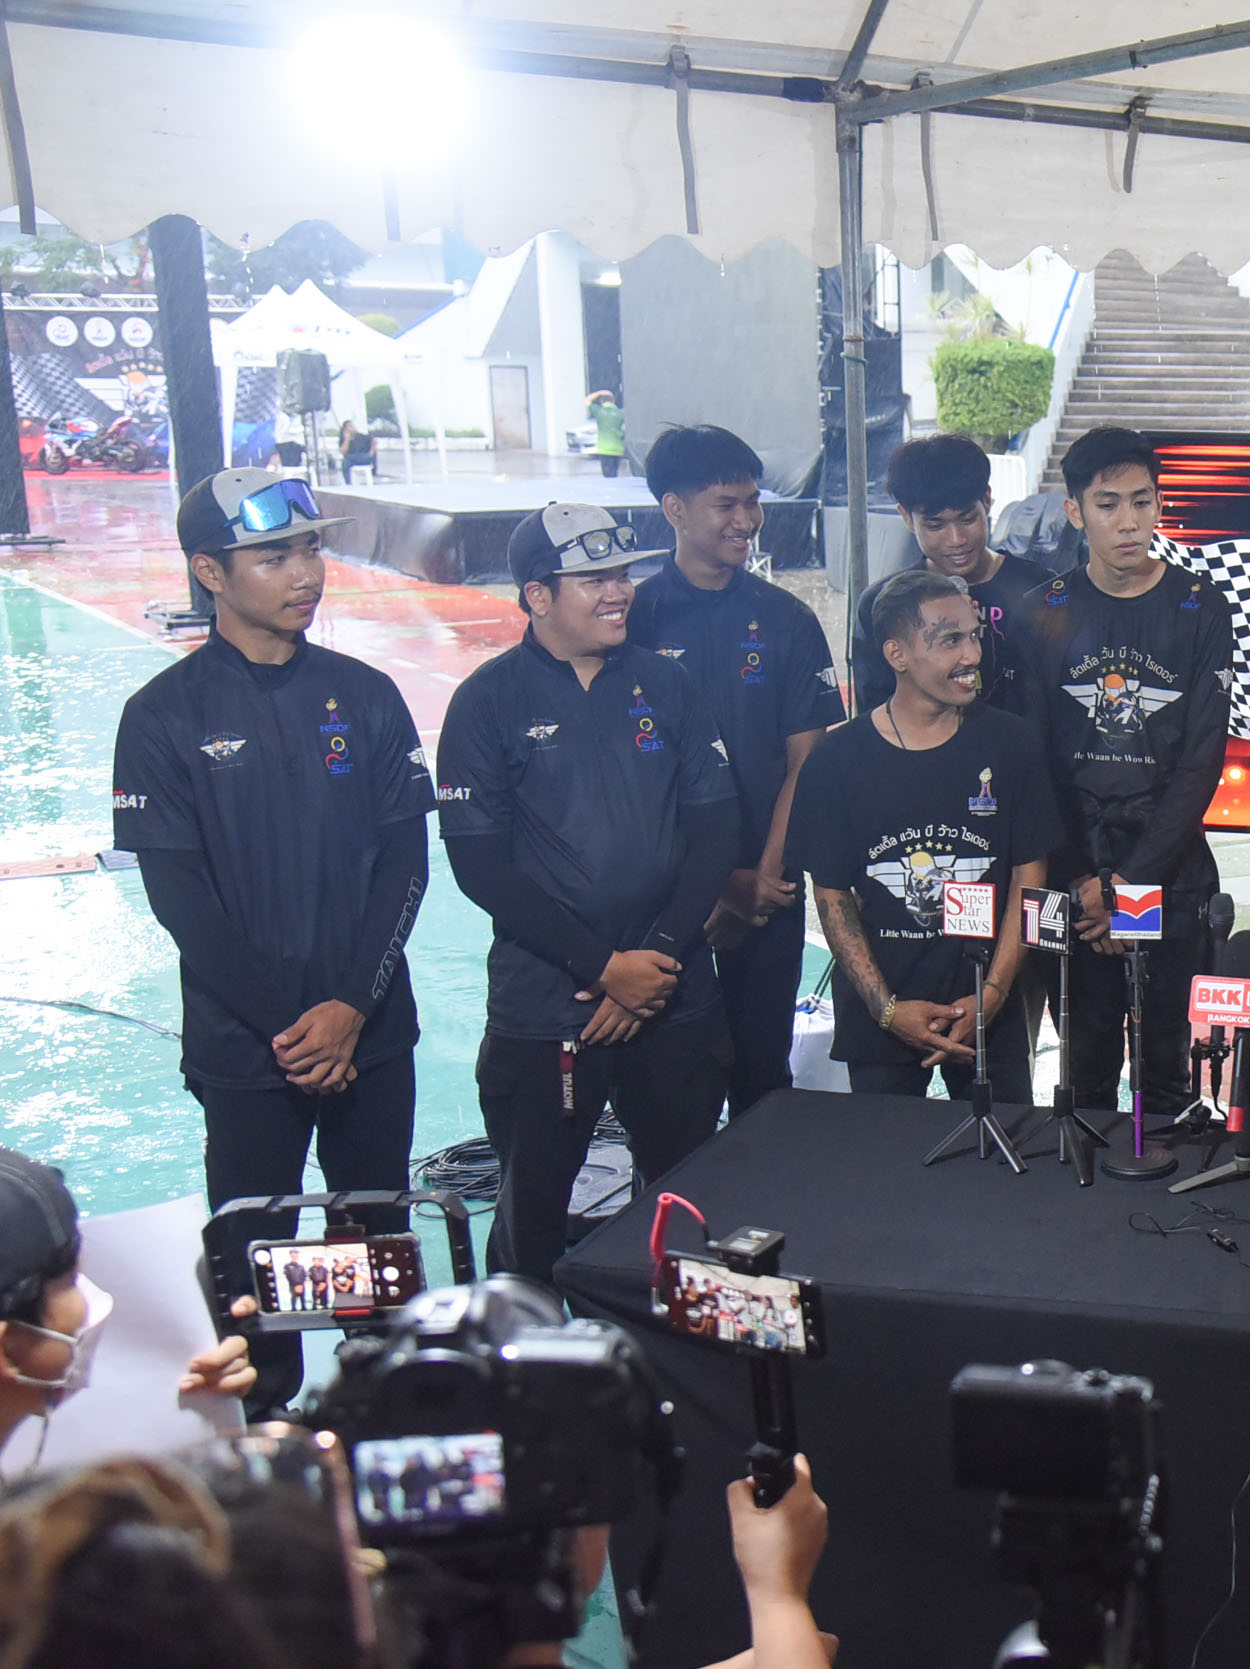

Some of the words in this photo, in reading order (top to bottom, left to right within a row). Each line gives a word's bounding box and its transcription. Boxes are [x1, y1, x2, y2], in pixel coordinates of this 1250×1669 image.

[925, 824, 934, 838] บี
[938, 824, 959, 838] ว้าว
[947, 918, 990, 933] NEWS
[1023, 893, 1065, 944] 14
[1197, 987, 1242, 1006] BKK
[1207, 1013, 1250, 1024] BANGKOK
[562, 1072, 575, 1109] MOTUL
